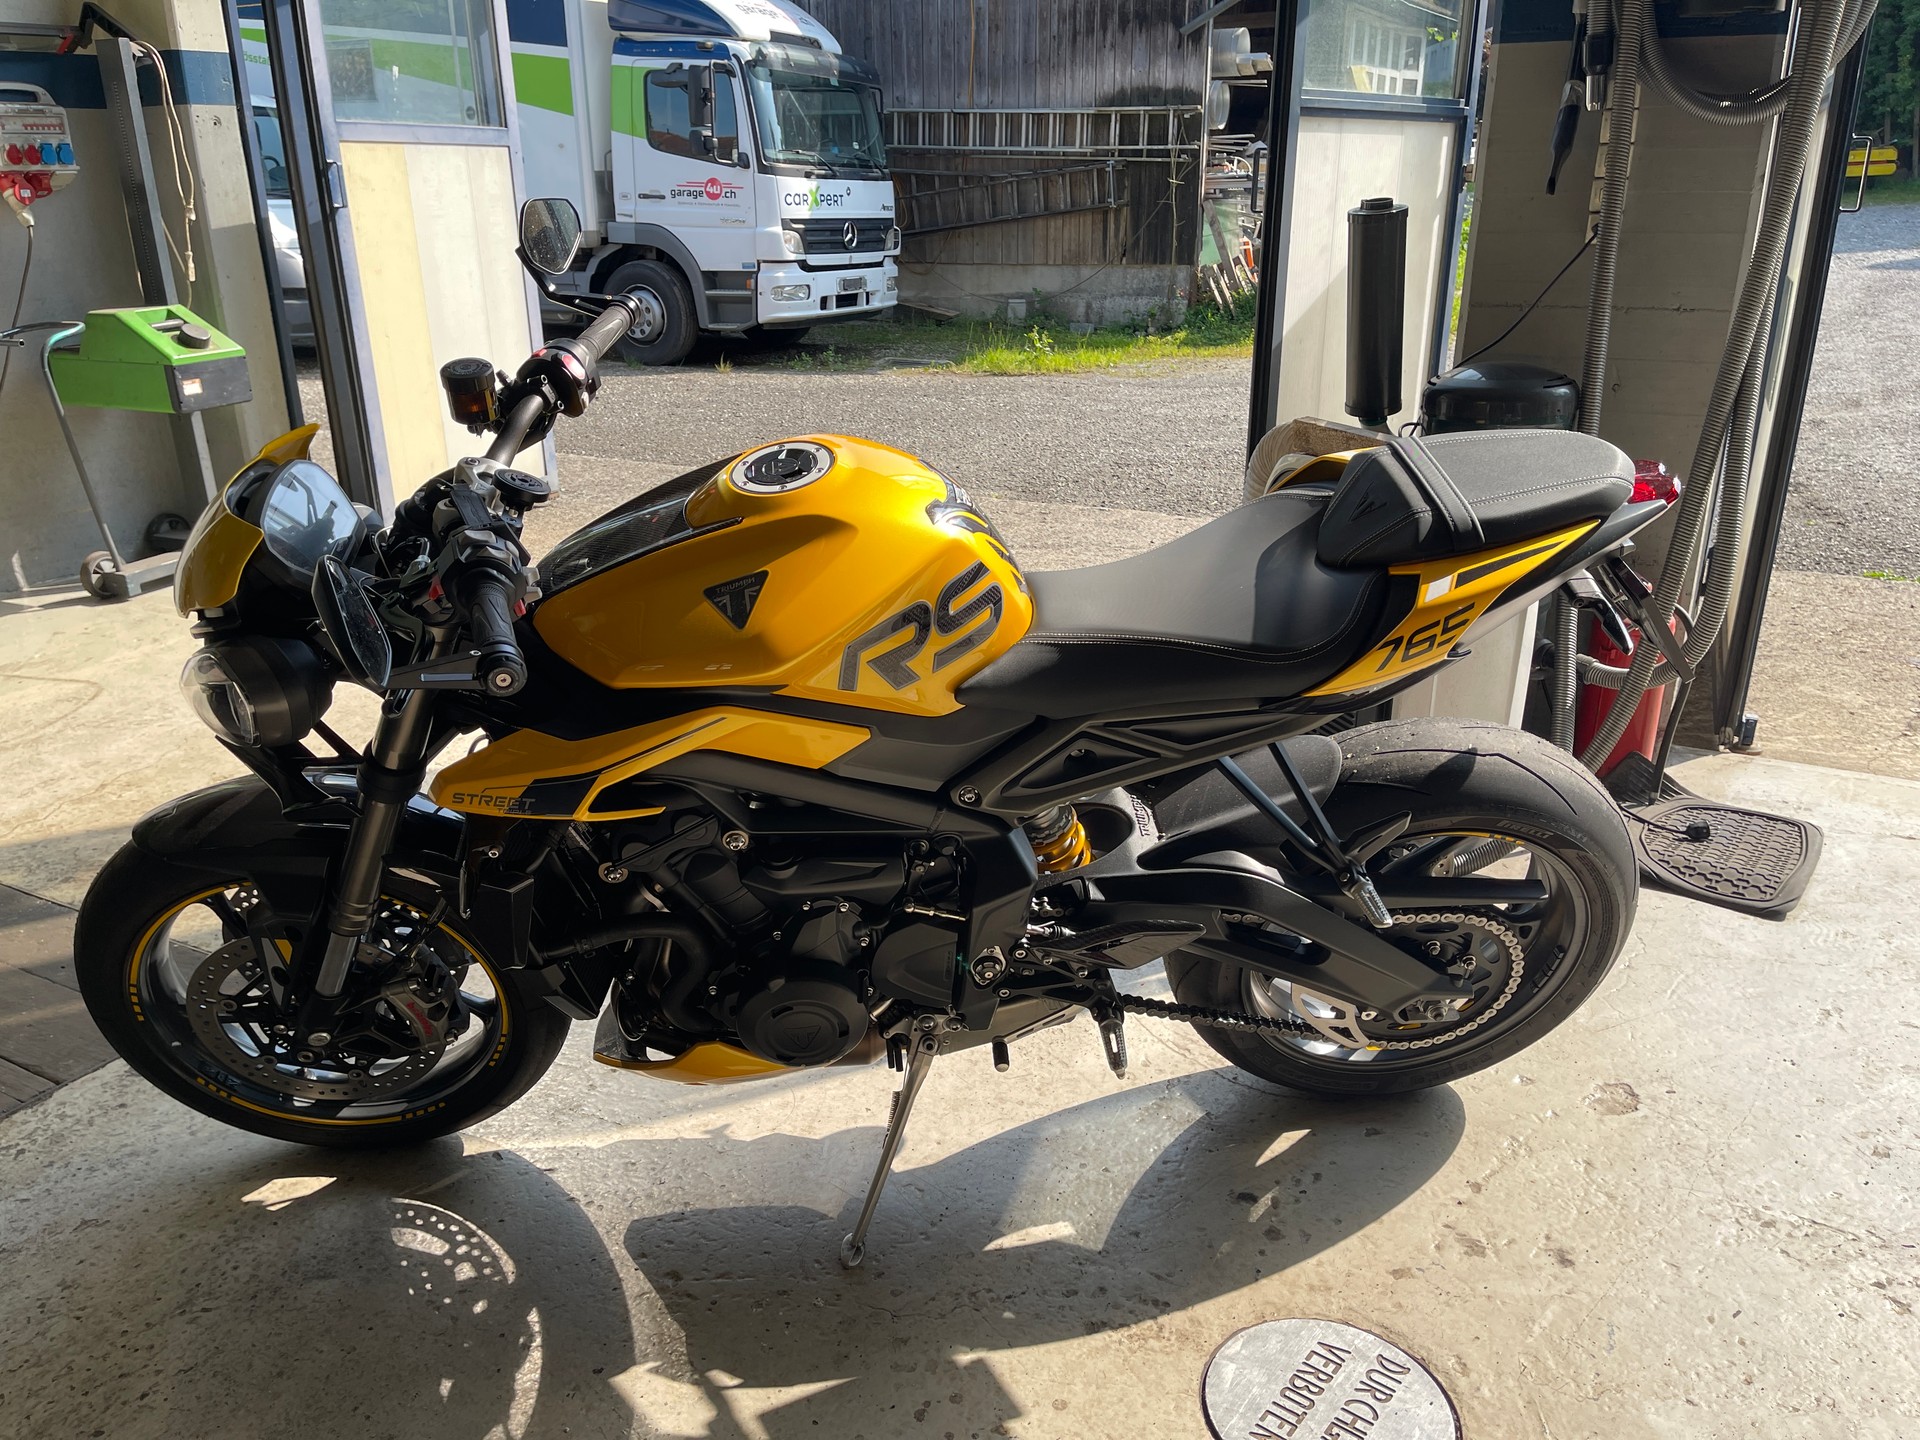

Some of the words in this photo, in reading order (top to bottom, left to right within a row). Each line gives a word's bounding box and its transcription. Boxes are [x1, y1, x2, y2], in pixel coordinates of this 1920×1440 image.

[670, 182, 736, 199] garage4u.ch
[715, 577, 755, 594] TRIUMPH
[838, 560, 1003, 692] RS
[1376, 602, 1476, 672] 765
[452, 792, 536, 808] STREET
[1321, 1353, 1411, 1440] DURCHG
